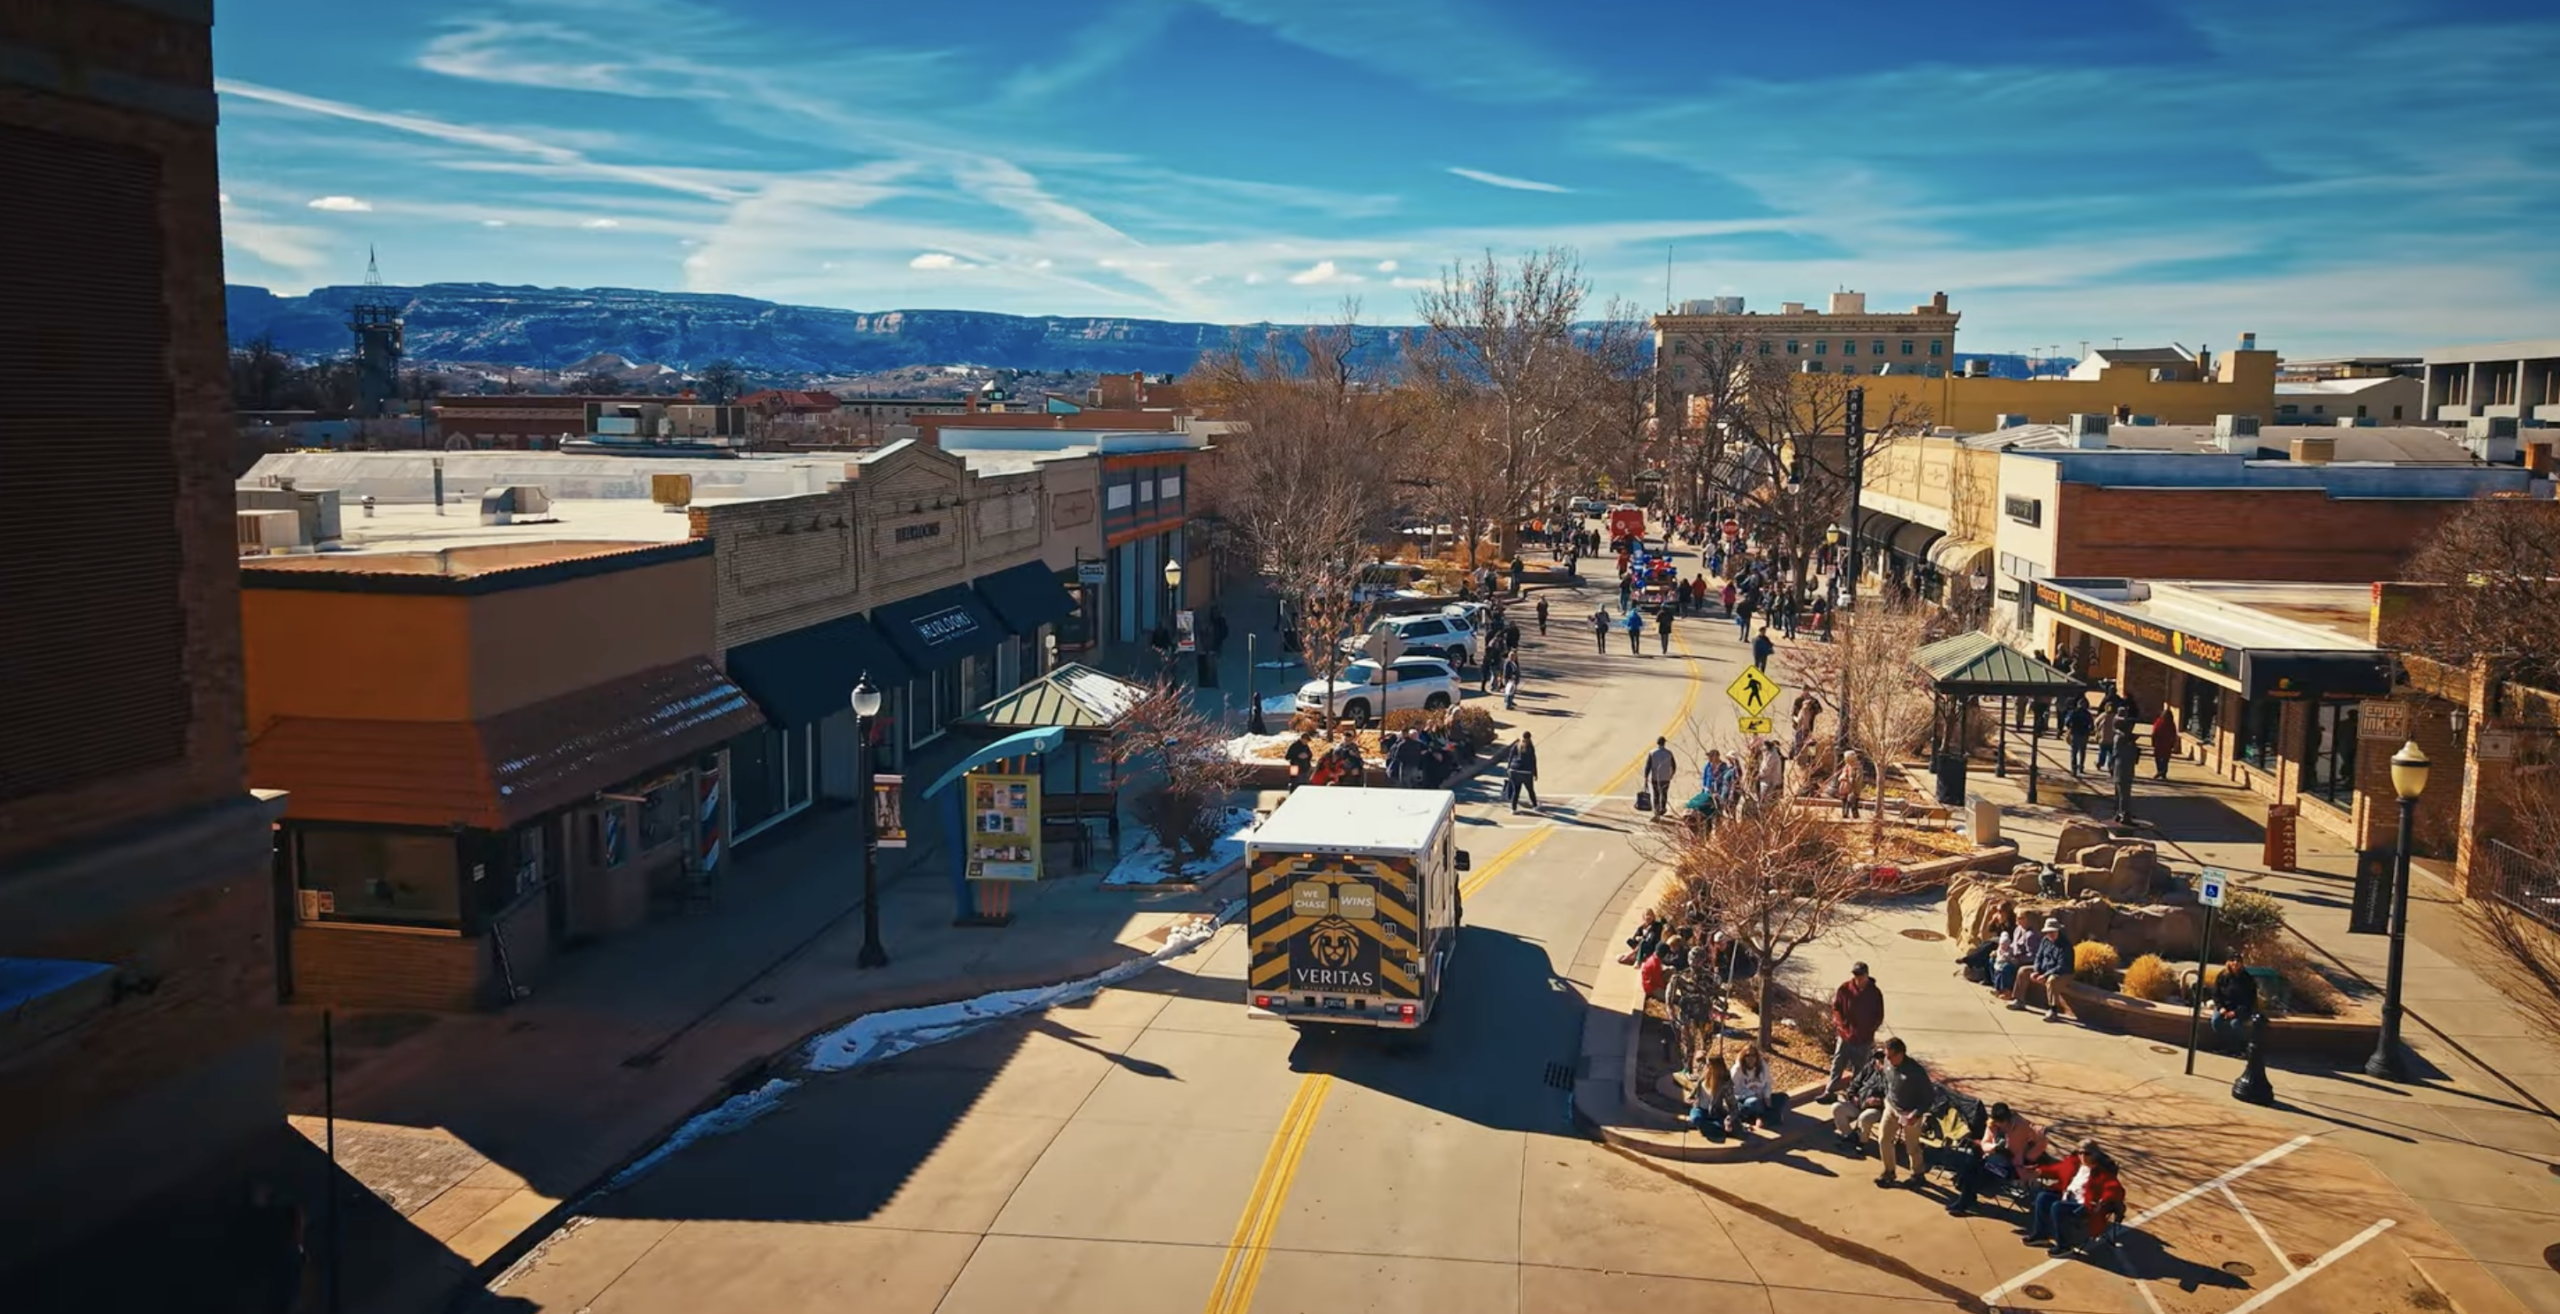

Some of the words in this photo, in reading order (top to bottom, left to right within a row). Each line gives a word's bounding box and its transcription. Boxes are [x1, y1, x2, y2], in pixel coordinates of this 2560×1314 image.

[918, 612, 971, 639] HEIRLOOMS
[2184, 635, 2223, 662] ProSpace
[1302, 890, 1318, 898] WE
[1294, 900, 1327, 910] CHASE
[1297, 968, 1373, 986] VERITAS
